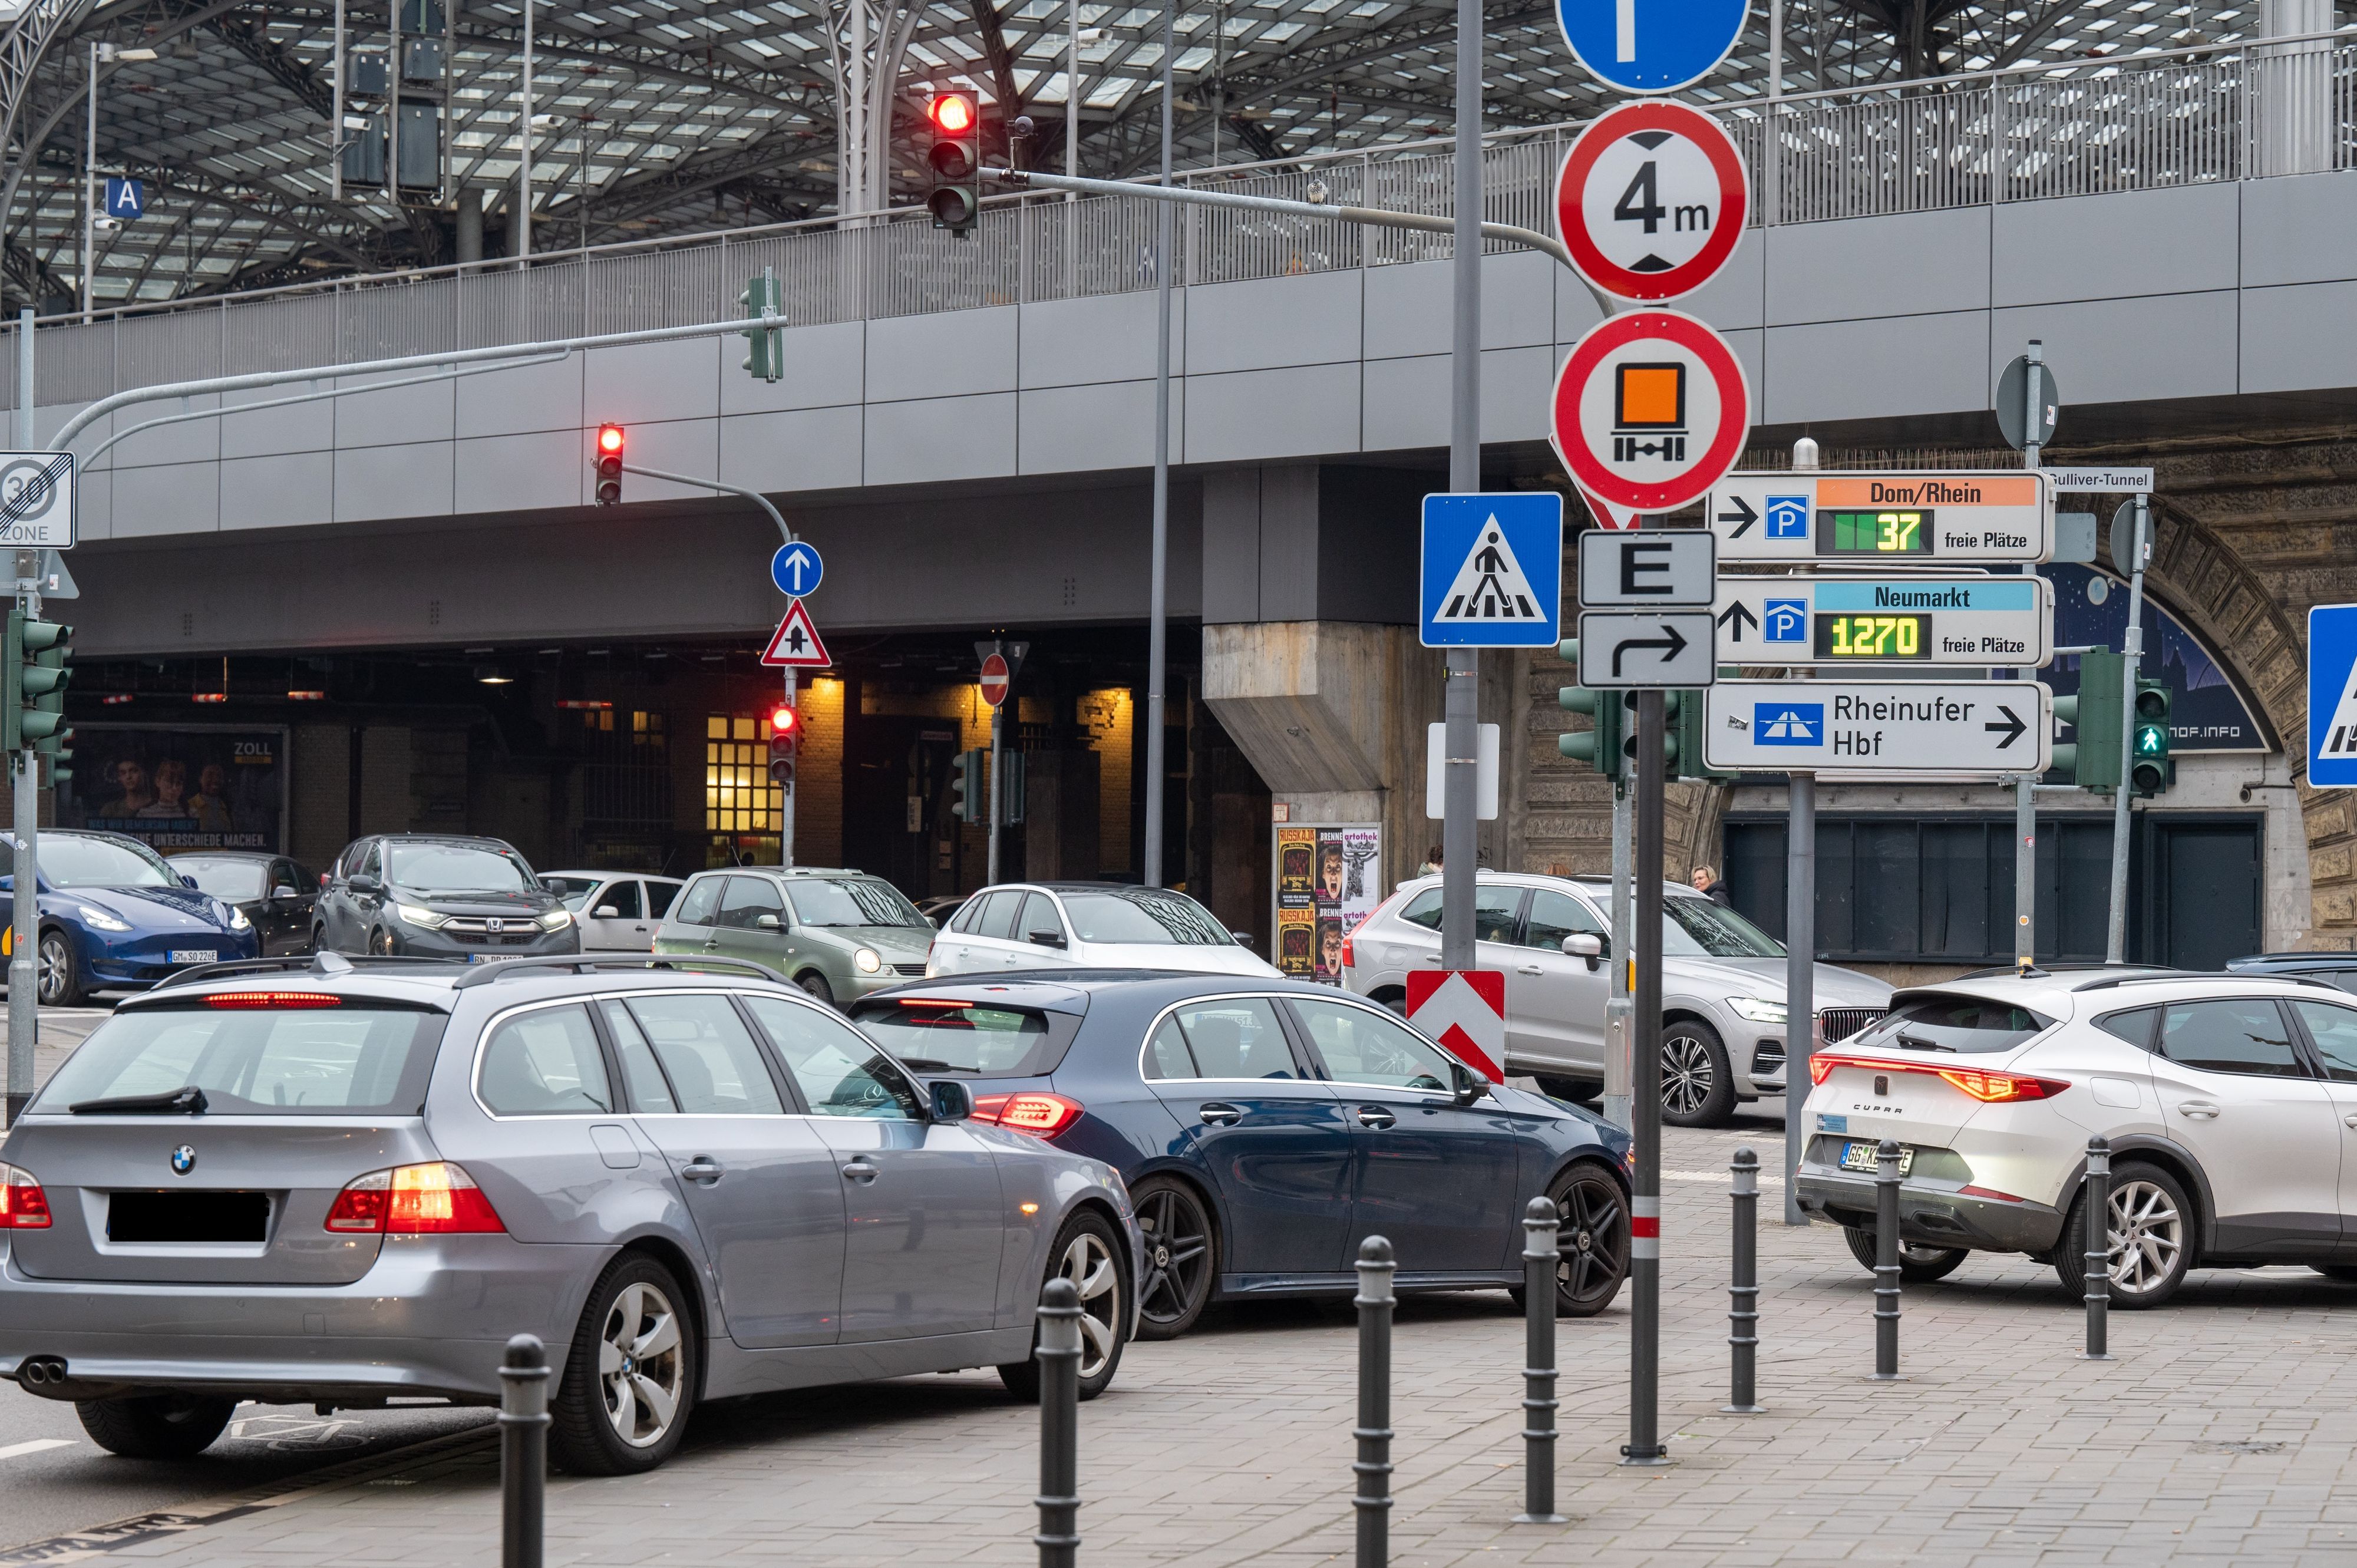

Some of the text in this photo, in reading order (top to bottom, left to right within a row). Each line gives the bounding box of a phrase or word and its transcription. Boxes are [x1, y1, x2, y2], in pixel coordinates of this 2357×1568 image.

[117, 182, 138, 210] A
[1613, 161, 1710, 234] 4 m
[8, 476, 43, 504] 30
[1870, 481, 1981, 506] Dom/Rhein
[1, 526, 48, 540] ZONE
[1877, 514, 1920, 550] 37
[1945, 532, 2027, 548] freie Plätze
[1620, 543, 1673, 595] E
[1874, 586, 1970, 608] Neumarkt
[1833, 618, 1918, 654] 1270
[1943, 637, 2025, 652] freie Plätze
[1834, 695, 1975, 721] Rheinufer
[235, 742, 272, 755] ZOLL
[1834, 730, 1882, 755] Hbf
[154, 833, 220, 847] UNTERSCHIEDE
[224, 833, 267, 847] MACHEN.
[1344, 831, 1377, 842] artothek
[173, 952, 183, 961] GM
[199, 952, 216, 961] 226E
[1853, 1104, 1903, 1114] CUPRA
[1848, 1146, 1863, 1163] GG
